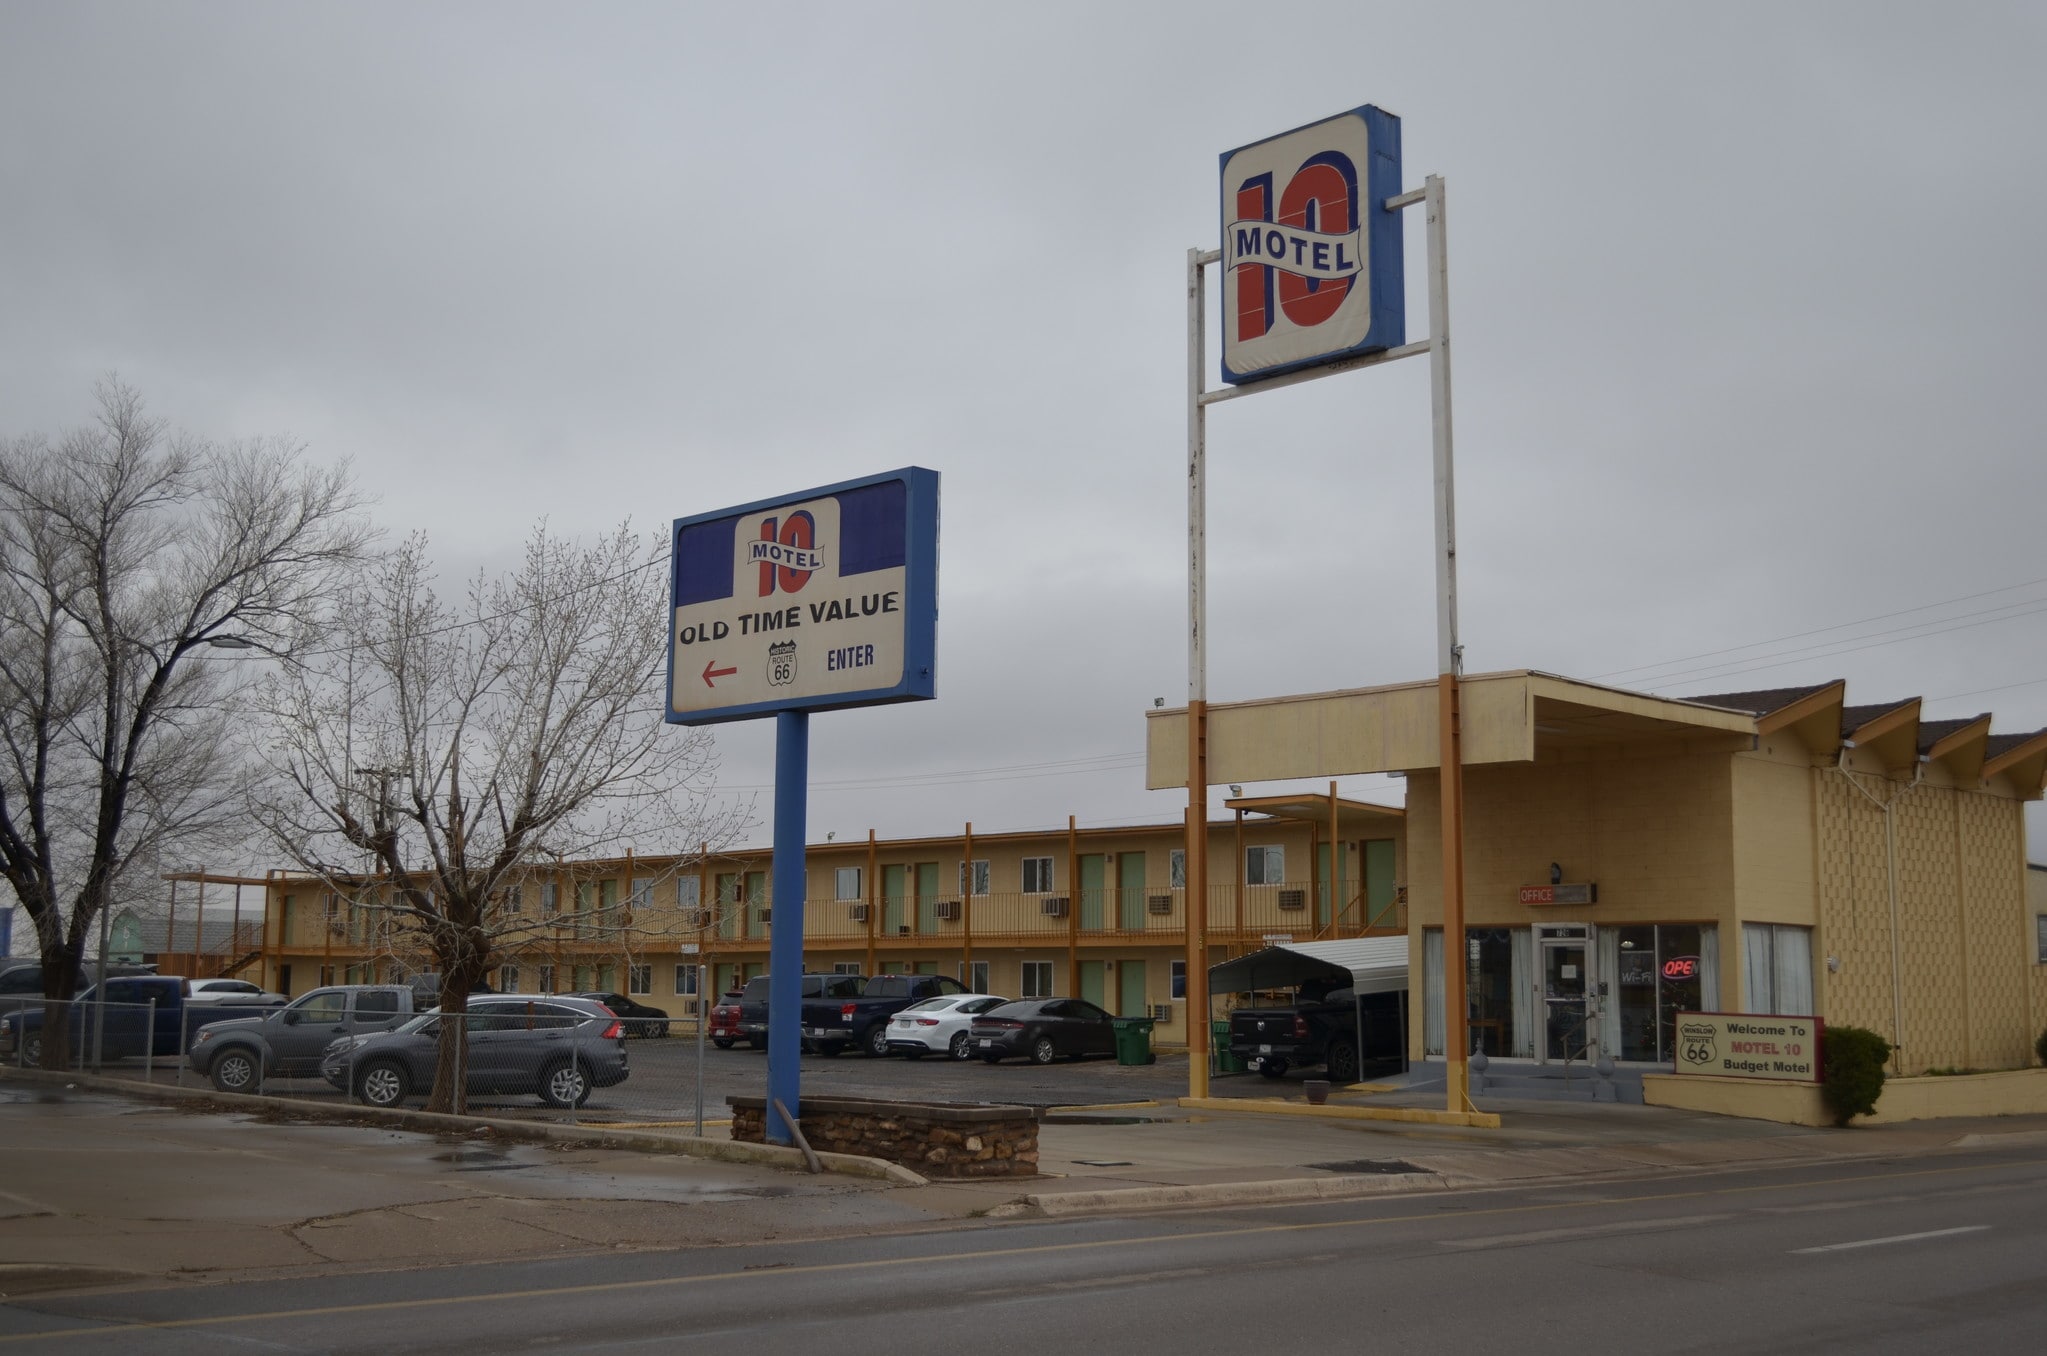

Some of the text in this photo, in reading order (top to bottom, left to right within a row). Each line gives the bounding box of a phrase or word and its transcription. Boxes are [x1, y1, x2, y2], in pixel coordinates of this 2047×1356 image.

[1236, 227, 1354, 272] MOTEL
[1237, 150, 1359, 343] 10
[752, 543, 820, 567] MOTEL
[758, 509, 816, 598] 10
[680, 591, 899, 645] OLD TIME VALUE
[770, 645, 796, 656] HISTORIC
[827, 644, 874, 671] ENTER
[772, 654, 793, 665] ROUTE
[774, 663, 790, 681] 66
[1520, 889, 1552, 902] OFFICE
[1665, 960, 1699, 976] OPEN
[1684, 1027, 1713, 1035] WINSLOW
[1726, 1023, 1806, 1037] Welcome To
[1687, 1043, 1709, 1061] 66
[1731, 1041, 1801, 1056] MOTEL 10
[1723, 1059, 1810, 1073] Budget Motel
